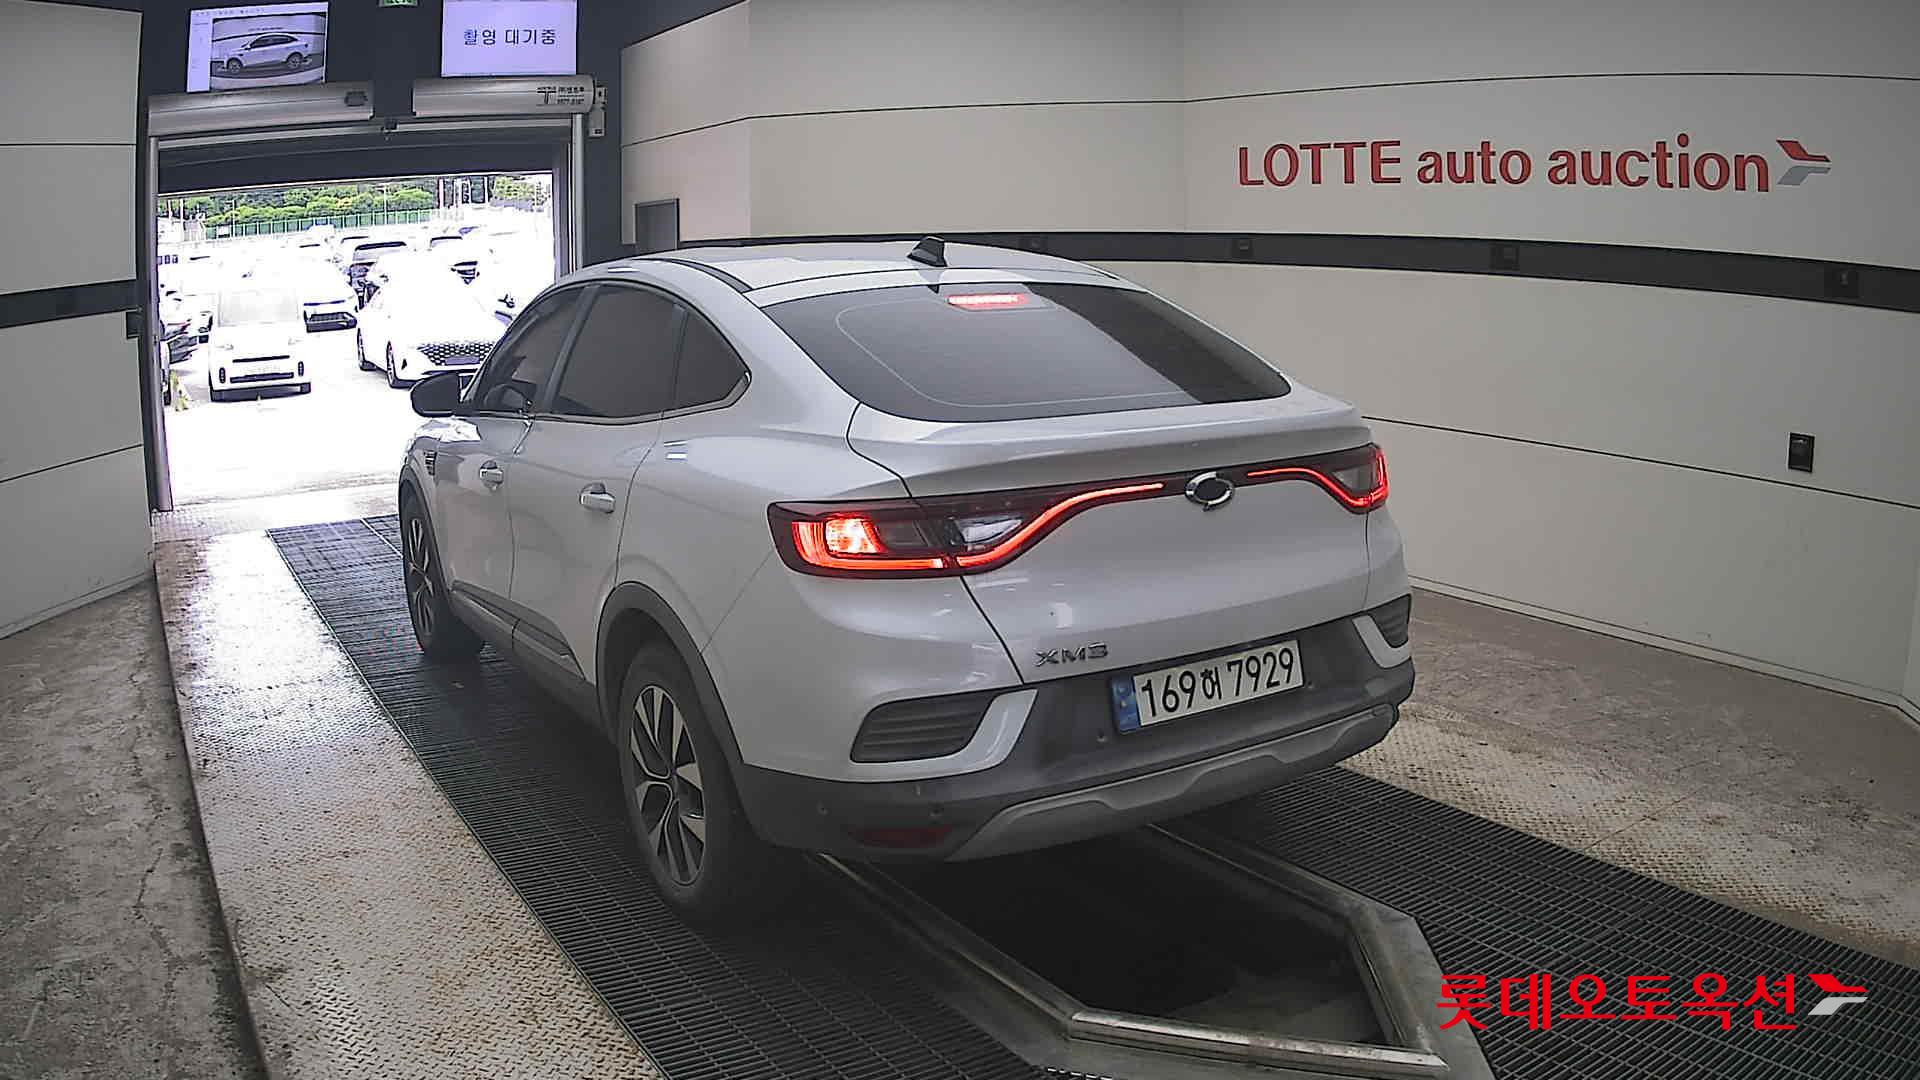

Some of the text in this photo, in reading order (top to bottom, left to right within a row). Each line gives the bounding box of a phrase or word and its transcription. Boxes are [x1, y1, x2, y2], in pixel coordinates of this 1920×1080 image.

[504, 28, 556, 46] 대기중
[1238, 132, 1770, 193] LOTTE auto auction
[1034, 641, 1109, 668] XM3
